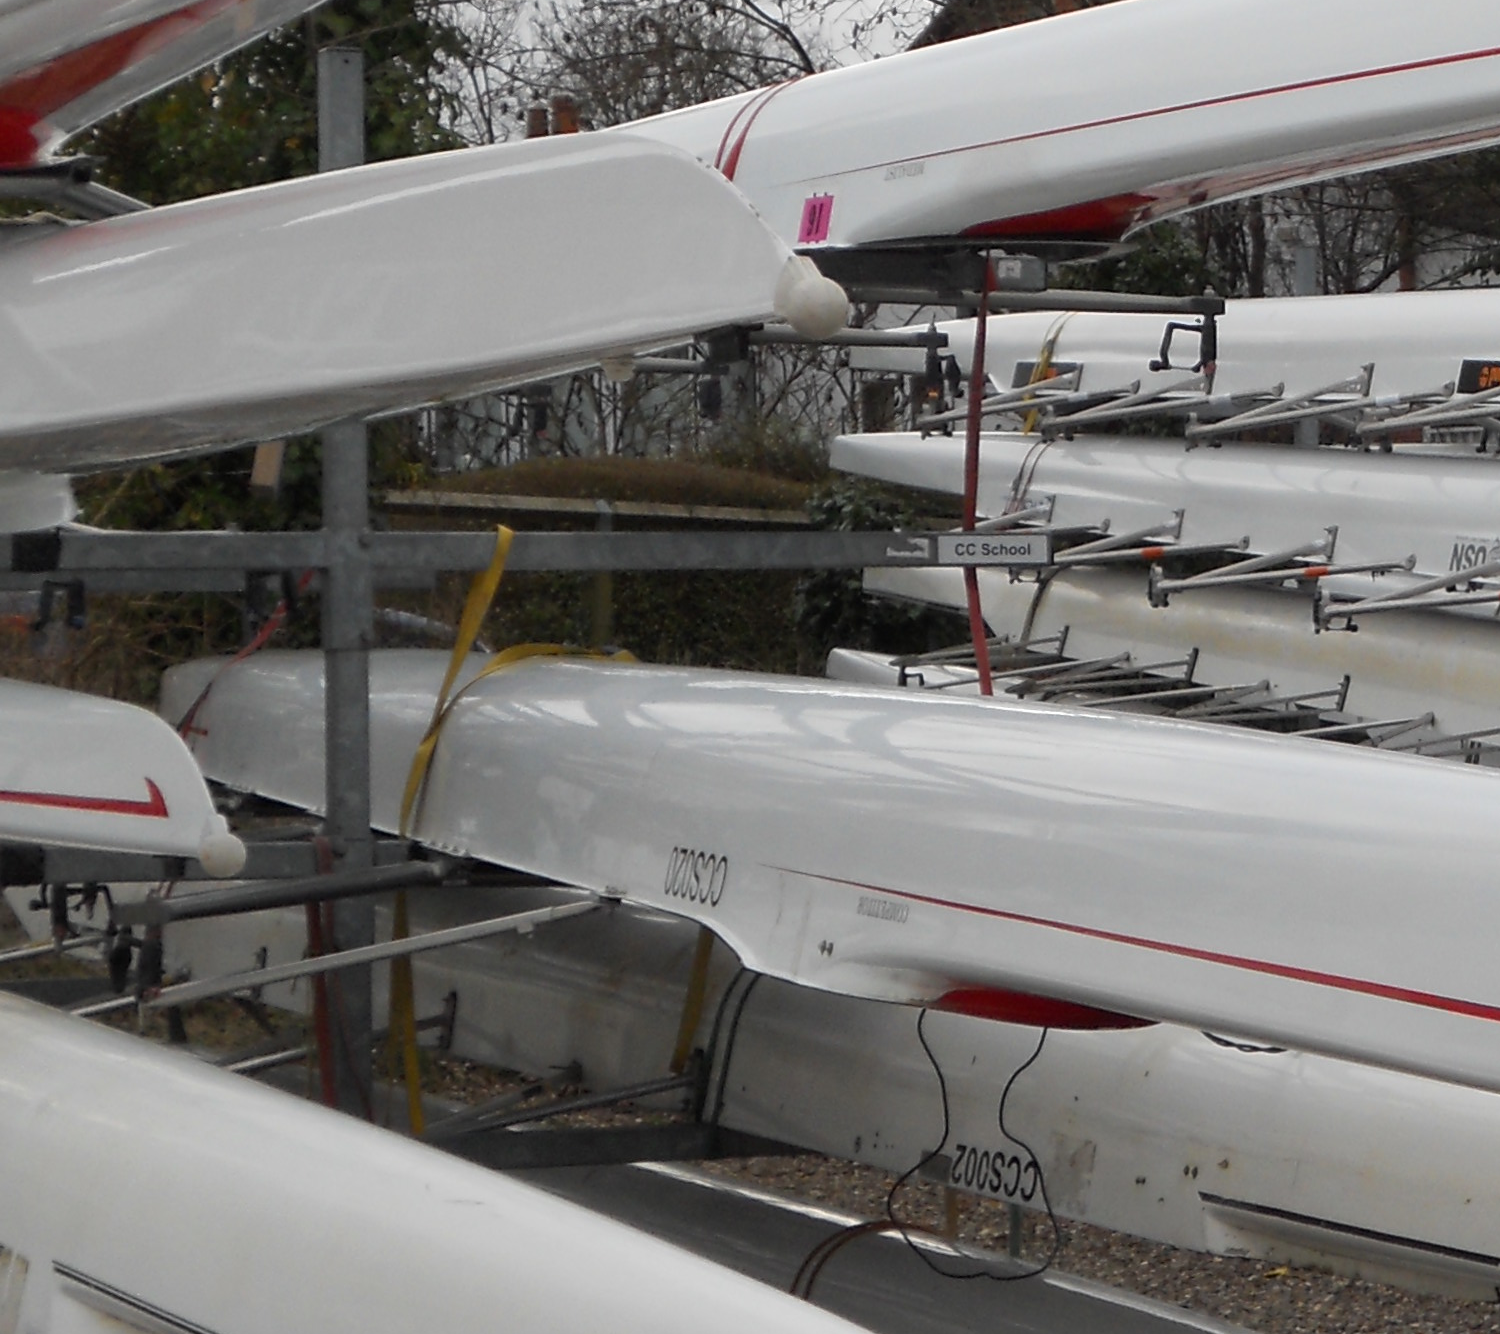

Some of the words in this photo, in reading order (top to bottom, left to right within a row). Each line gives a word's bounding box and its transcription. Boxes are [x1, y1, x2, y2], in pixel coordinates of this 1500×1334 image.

[954, 542, 977, 557] CC
[980, 542, 1032, 557] School
[664, 845, 729, 907] CCS020
[951, 1142, 1038, 1202] CCS002
